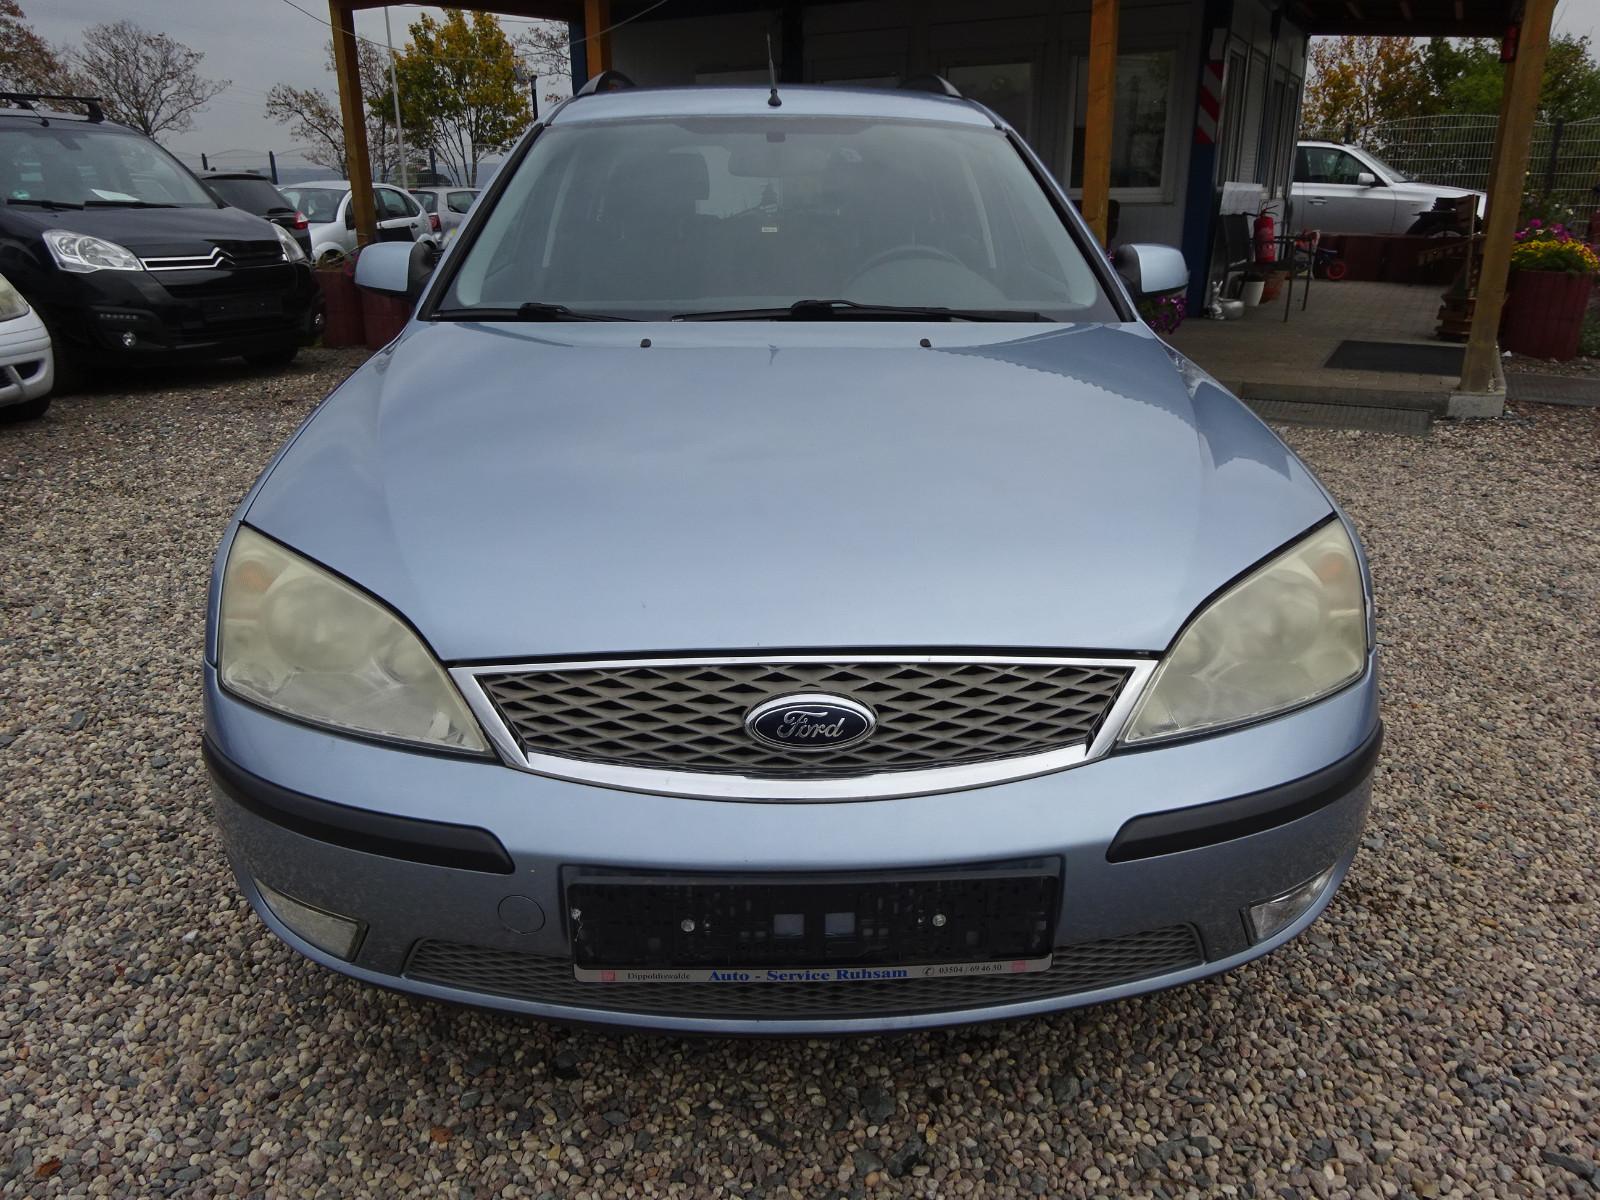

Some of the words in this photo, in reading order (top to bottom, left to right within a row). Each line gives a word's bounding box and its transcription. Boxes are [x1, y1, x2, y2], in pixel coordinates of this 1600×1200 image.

[777, 710, 845, 738] Ford
[709, 970, 749, 981] Auto
[767, 970, 830, 981] Service
[836, 968, 908, 980] Ruhsam
